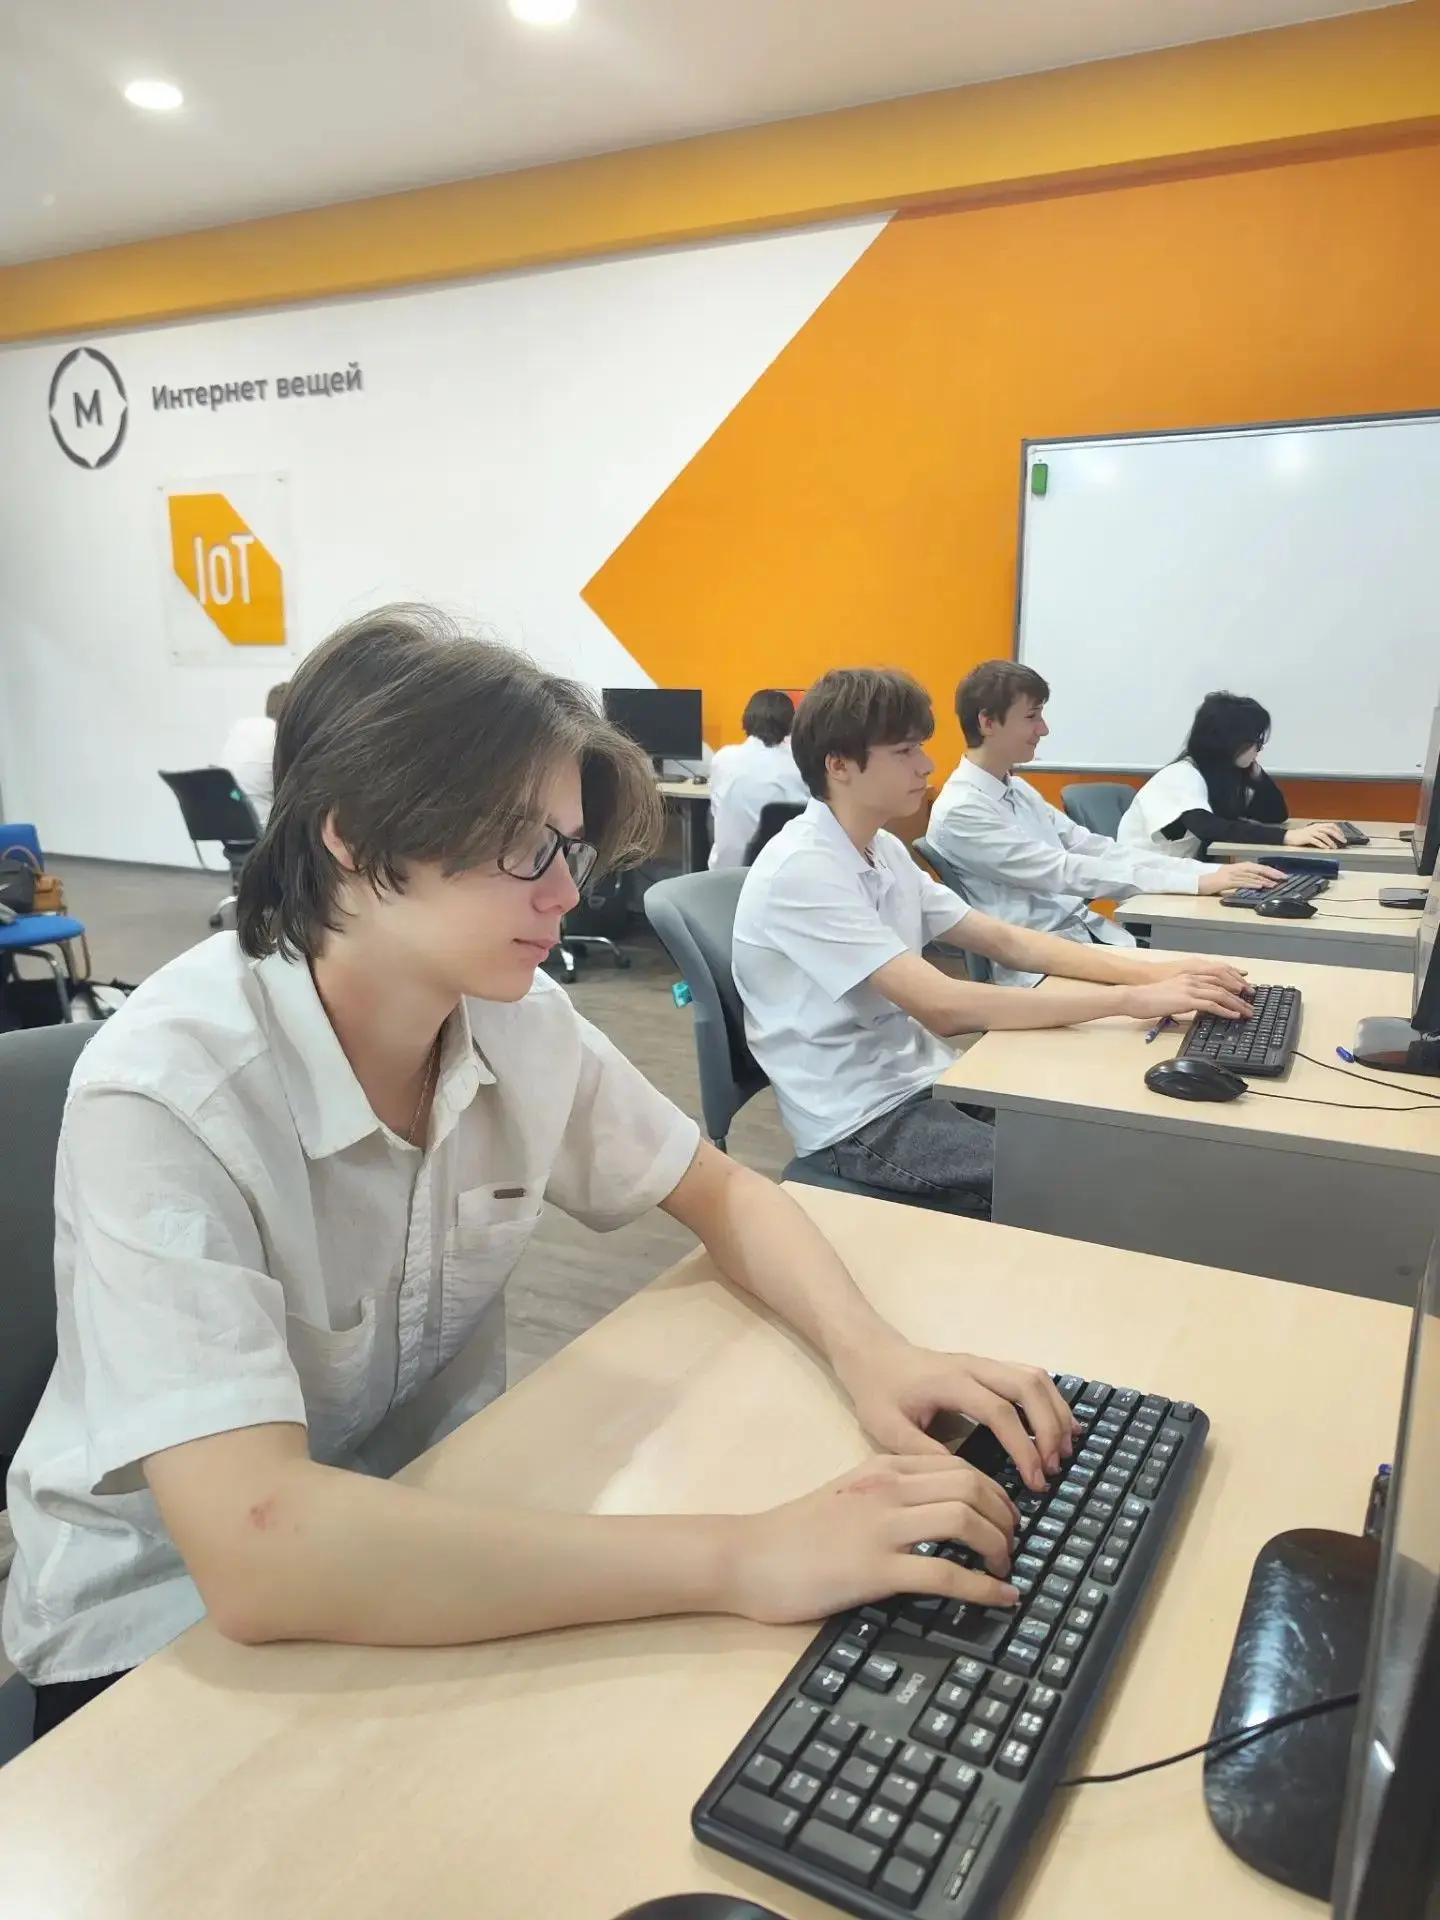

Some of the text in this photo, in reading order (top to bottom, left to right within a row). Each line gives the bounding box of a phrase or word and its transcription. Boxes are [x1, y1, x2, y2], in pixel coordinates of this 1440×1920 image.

[152, 361, 363, 411] Интернет вещей
[194, 533, 255, 605] IoT
